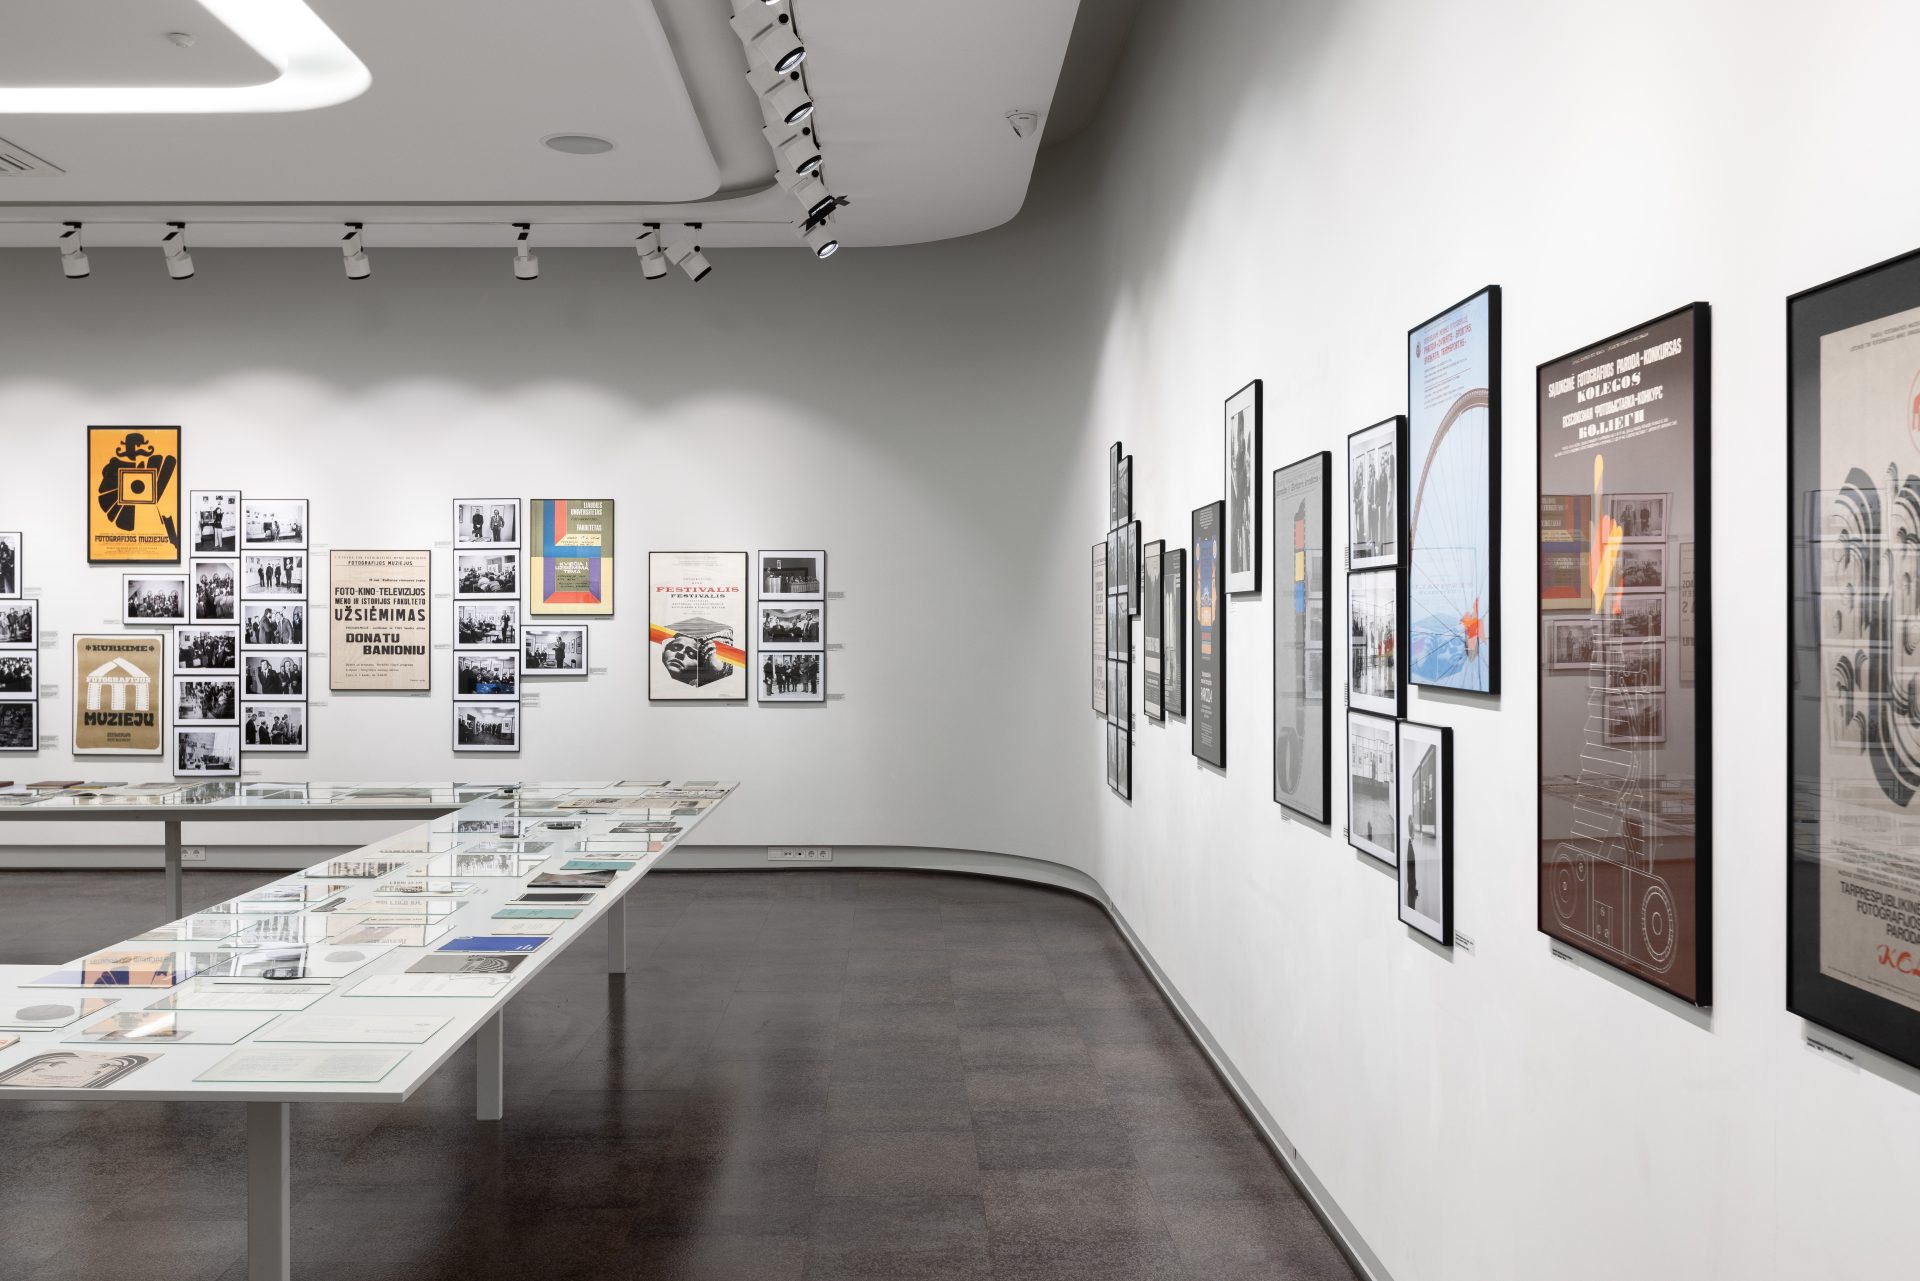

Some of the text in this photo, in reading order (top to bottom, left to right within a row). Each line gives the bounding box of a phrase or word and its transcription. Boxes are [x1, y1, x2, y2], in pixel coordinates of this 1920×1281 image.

[1577, 361, 1615, 389] FOTOGRAFIJOS
[1577, 371, 1641, 403] KOLEGOS
[1578, 409, 1645, 440] КОЛЛЕГИ
[95, 535, 169, 543] FOTOGRAFIJOS MUZIEJUS
[335, 597, 351, 605] MENO
[353, 597, 359, 605] IR
[361, 597, 391, 605] ISTORIJOS
[335, 605, 426, 621] UŽSIĖMIMAS
[345, 633, 400, 643] DONATU
[363, 645, 426, 655] BANIONIU
[84, 711, 154, 727] MUZIEJŲ
